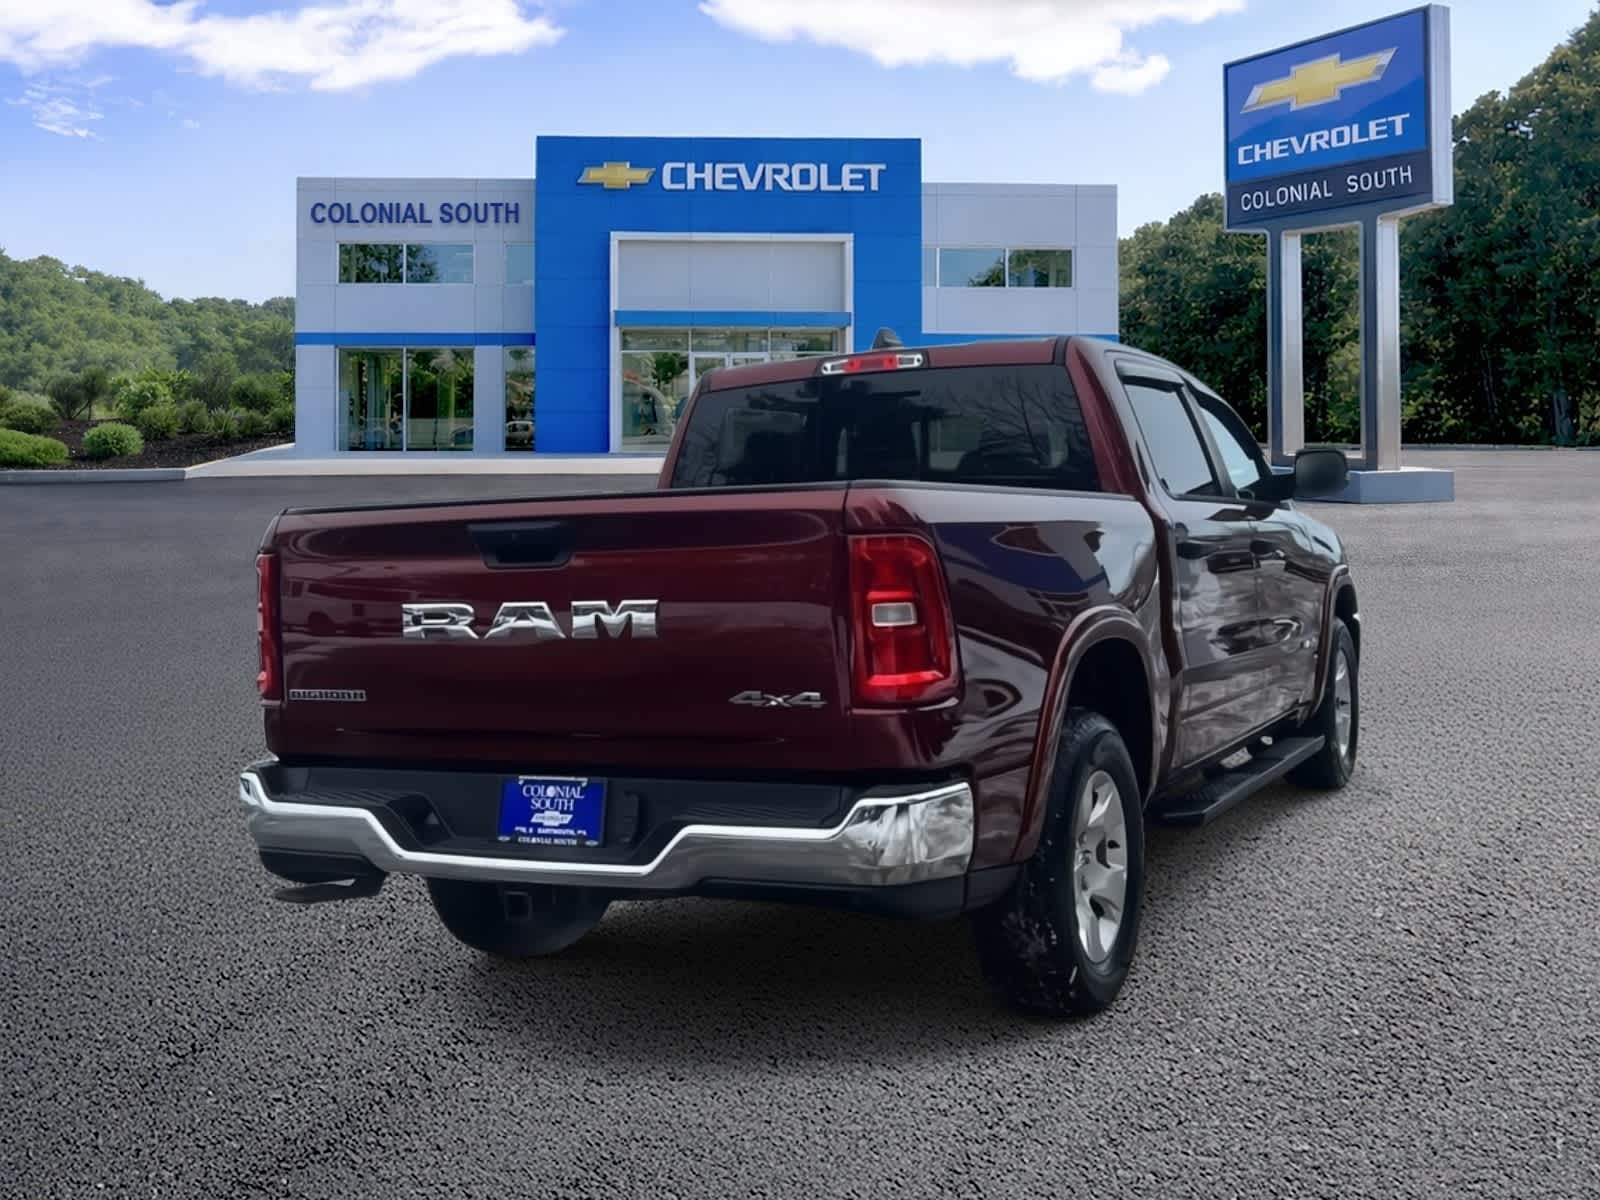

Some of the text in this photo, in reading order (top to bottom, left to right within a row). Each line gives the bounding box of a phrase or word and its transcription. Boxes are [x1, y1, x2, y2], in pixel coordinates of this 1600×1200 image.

[1237, 113, 1410, 165] CHEVROLET
[661, 161, 886, 192] CHEVROLET
[1240, 165, 1413, 212] COLONIAL SOUTH
[310, 201, 521, 225] COLONIAL SOUTH
[401, 599, 660, 640] RAM
[522, 784, 585, 799] COLONIAL
[530, 798, 575, 811] SOUTH
